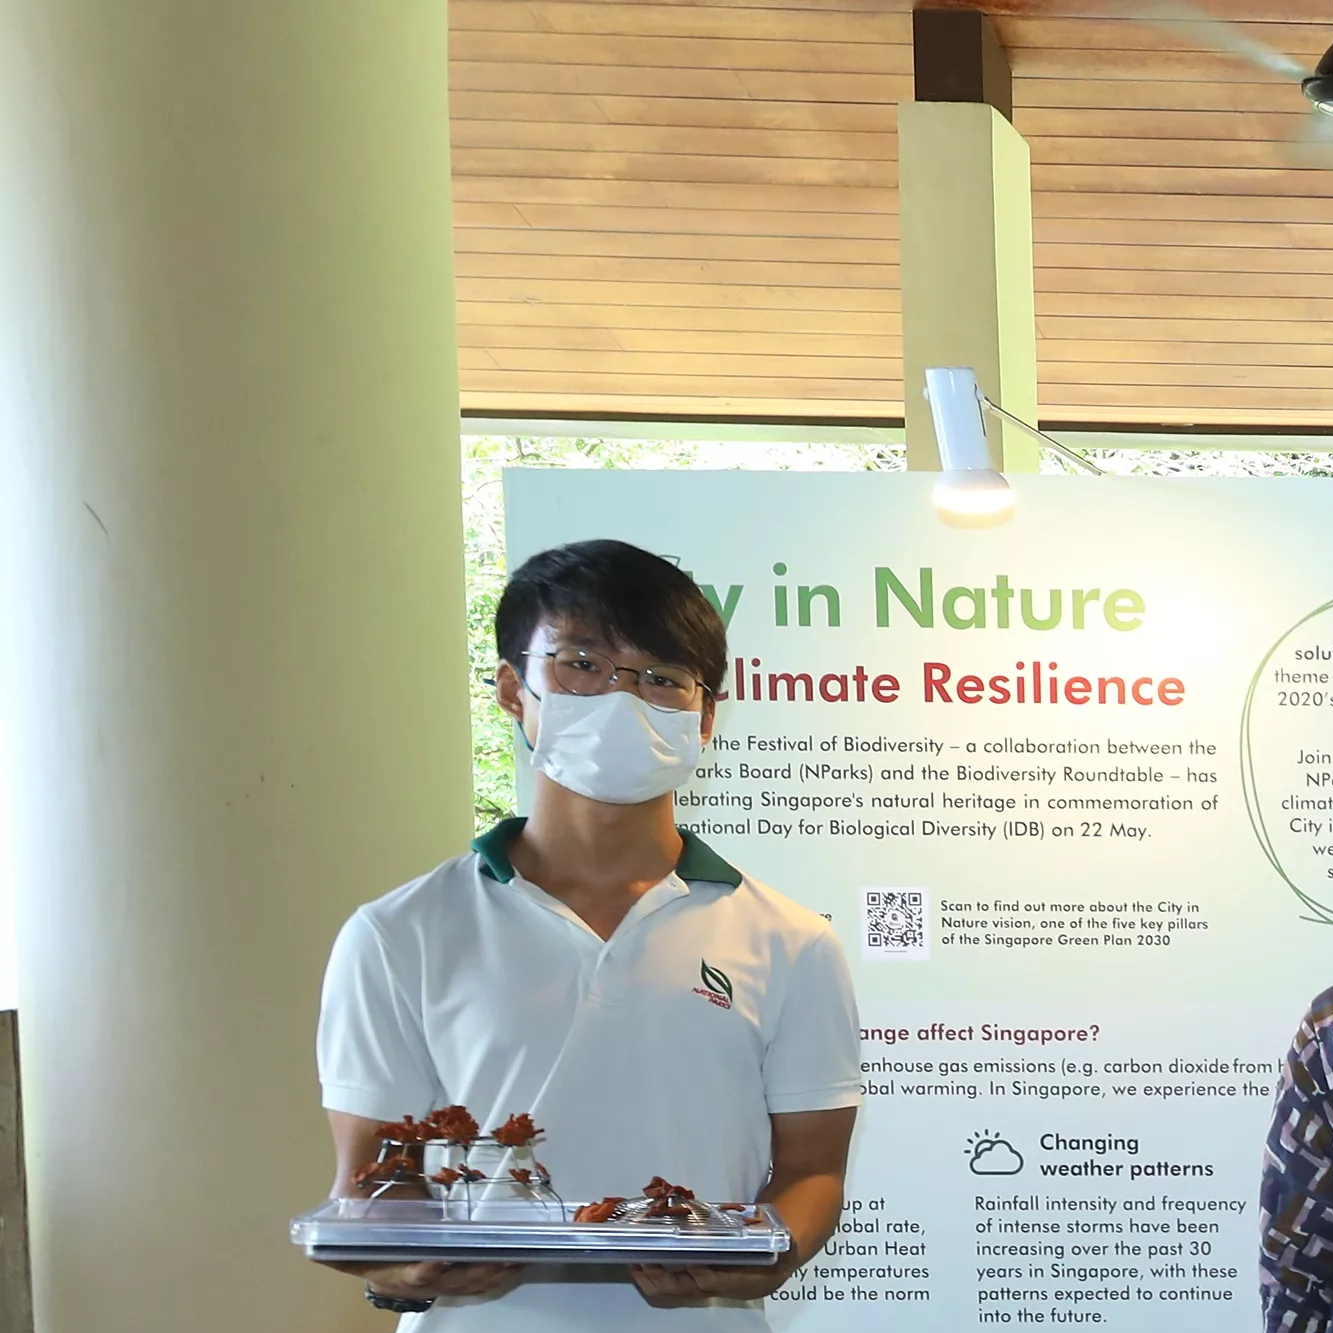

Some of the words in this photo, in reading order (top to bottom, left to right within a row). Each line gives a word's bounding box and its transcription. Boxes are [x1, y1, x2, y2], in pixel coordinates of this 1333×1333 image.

[772, 561, 841, 628] in
[874, 566, 1146, 633] Nature
[713, 656, 902, 705] limate
[923, 660, 1186, 707] Resilience
[1274, 667, 1329, 684] theme
[709, 733, 741, 751] the
[747, 735, 813, 752] Festival
[819, 735, 838, 752] of
[843, 735, 944, 757] Biodiversity
[965, 742, 977, 754] a
[983, 737, 1100, 754] collaboration
[1107, 738, 1182, 755] between
[1189, 739, 1217, 756] the
[739, 762, 792, 780] Board
[799, 763, 873, 784] (NParks)
[880, 763, 915, 781] and
[921, 764, 950, 781] the
[956, 764, 1057, 786] Biodiversity
[1063, 766, 1164, 783] Roundtable
[1187, 767, 1218, 783] has
[940, 899, 972, 912] Scan
[976, 901, 990, 912] to
[993, 899, 1020, 912] find
[1023, 902, 1046, 912] out
[1050, 903, 1085, 913] more
[1089, 900, 1128, 913] about
[1131, 901, 1153, 913] the
[1157, 900, 1183, 916] City
[1187, 901, 1200, 913] in
[941, 916, 989, 929] Nature
[991, 916, 1036, 931] vision,
[1039, 920, 1066, 929] one
[1069, 916, 1084, 929] of
[1086, 917, 1108, 930] the
[1111, 916, 1136, 930] five
[1140, 917, 1164, 932] key
[1167, 917, 1209, 933] pillars
[941, 932, 956, 945] of
[958, 932, 981, 945] the
[984, 933, 1053, 948] Singapore
[1057, 933, 1099, 946] Green
[1103, 933, 1132, 946] Plan
[1136, 934, 1171, 946] 2030
[916, 1022, 974, 1041] affect
[980, 1023, 1100, 1046] Singapore?
[1039, 1132, 1139, 1155] Changing
[1039, 1158, 1124, 1177] weather
[1130, 1161, 1214, 1181] patterns
[975, 1194, 1040, 1211] Rainfall
[1045, 1195, 1118, 1215] intensity
[1122, 1195, 1156, 1211] and
[1161, 1195, 1247, 1215] frequency
[975, 1217, 993, 1234] of
[998, 1217, 1061, 1234] intense
[1066, 1219, 1124, 1234] storms
[1129, 1217, 1171, 1234] have
[1176, 1217, 1219, 1234] been
